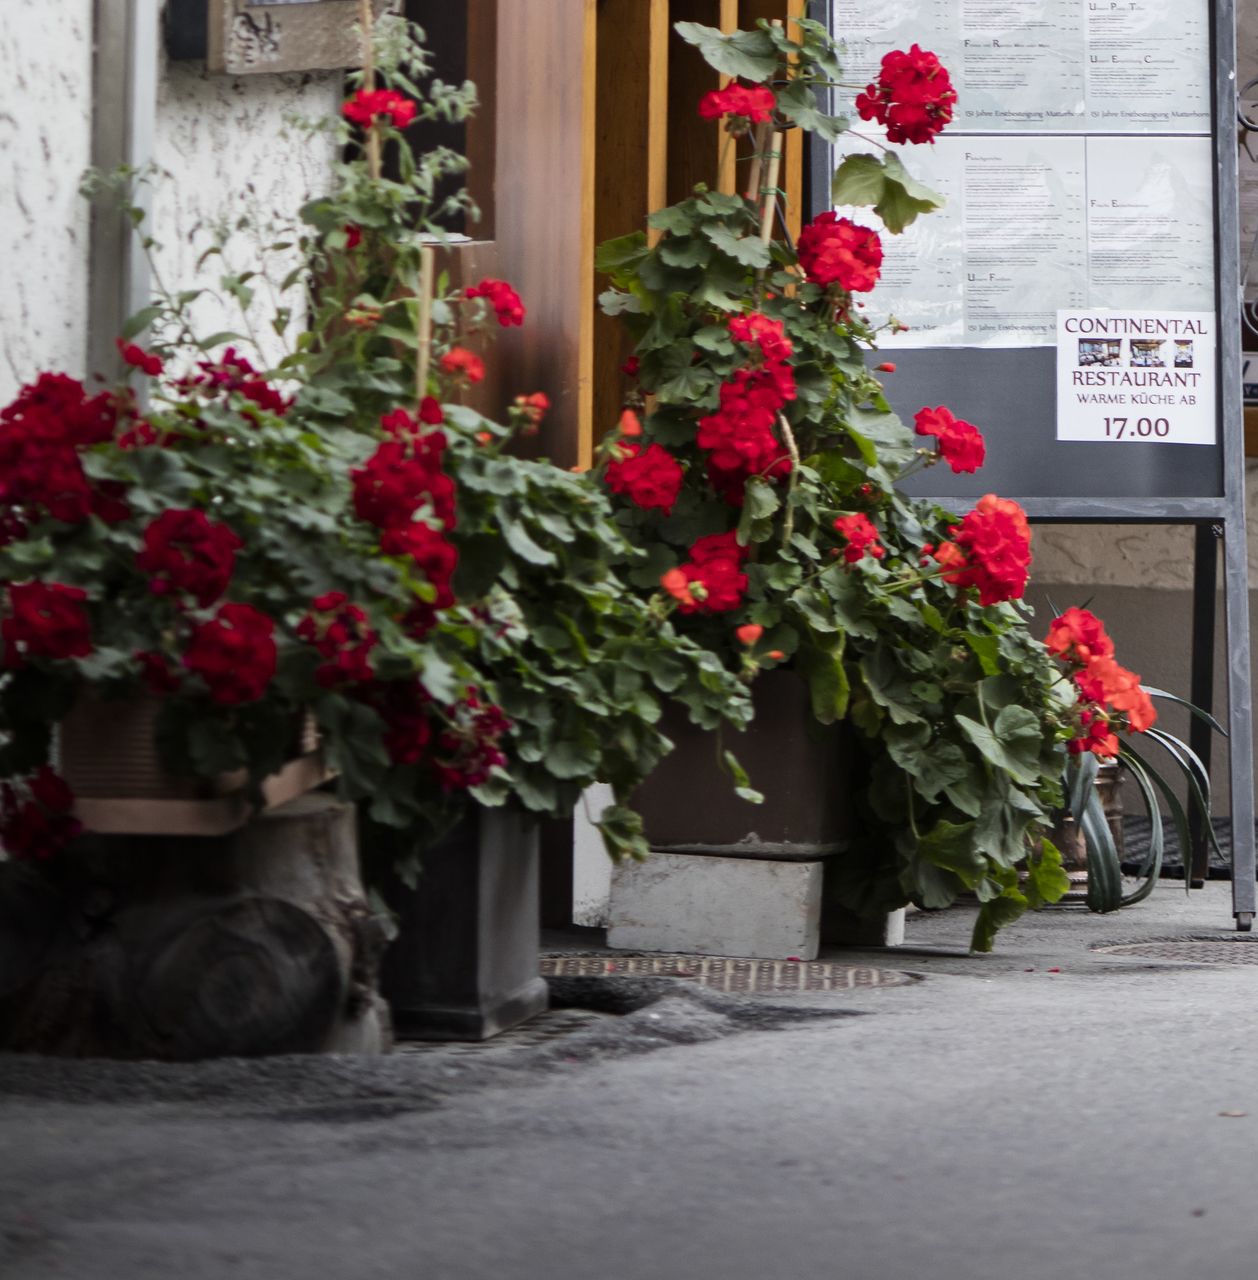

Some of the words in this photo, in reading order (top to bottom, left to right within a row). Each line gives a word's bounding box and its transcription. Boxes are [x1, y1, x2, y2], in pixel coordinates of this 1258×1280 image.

[1064, 317, 1208, 335] CONTINENTAL
[1072, 370, 1202, 388] RESTAURANT
[1076, 393, 1127, 405] WARME
[1130, 392, 1176, 406] KÜCHE
[1179, 396, 1197, 406] AB
[1103, 416, 1171, 440] 17.00
